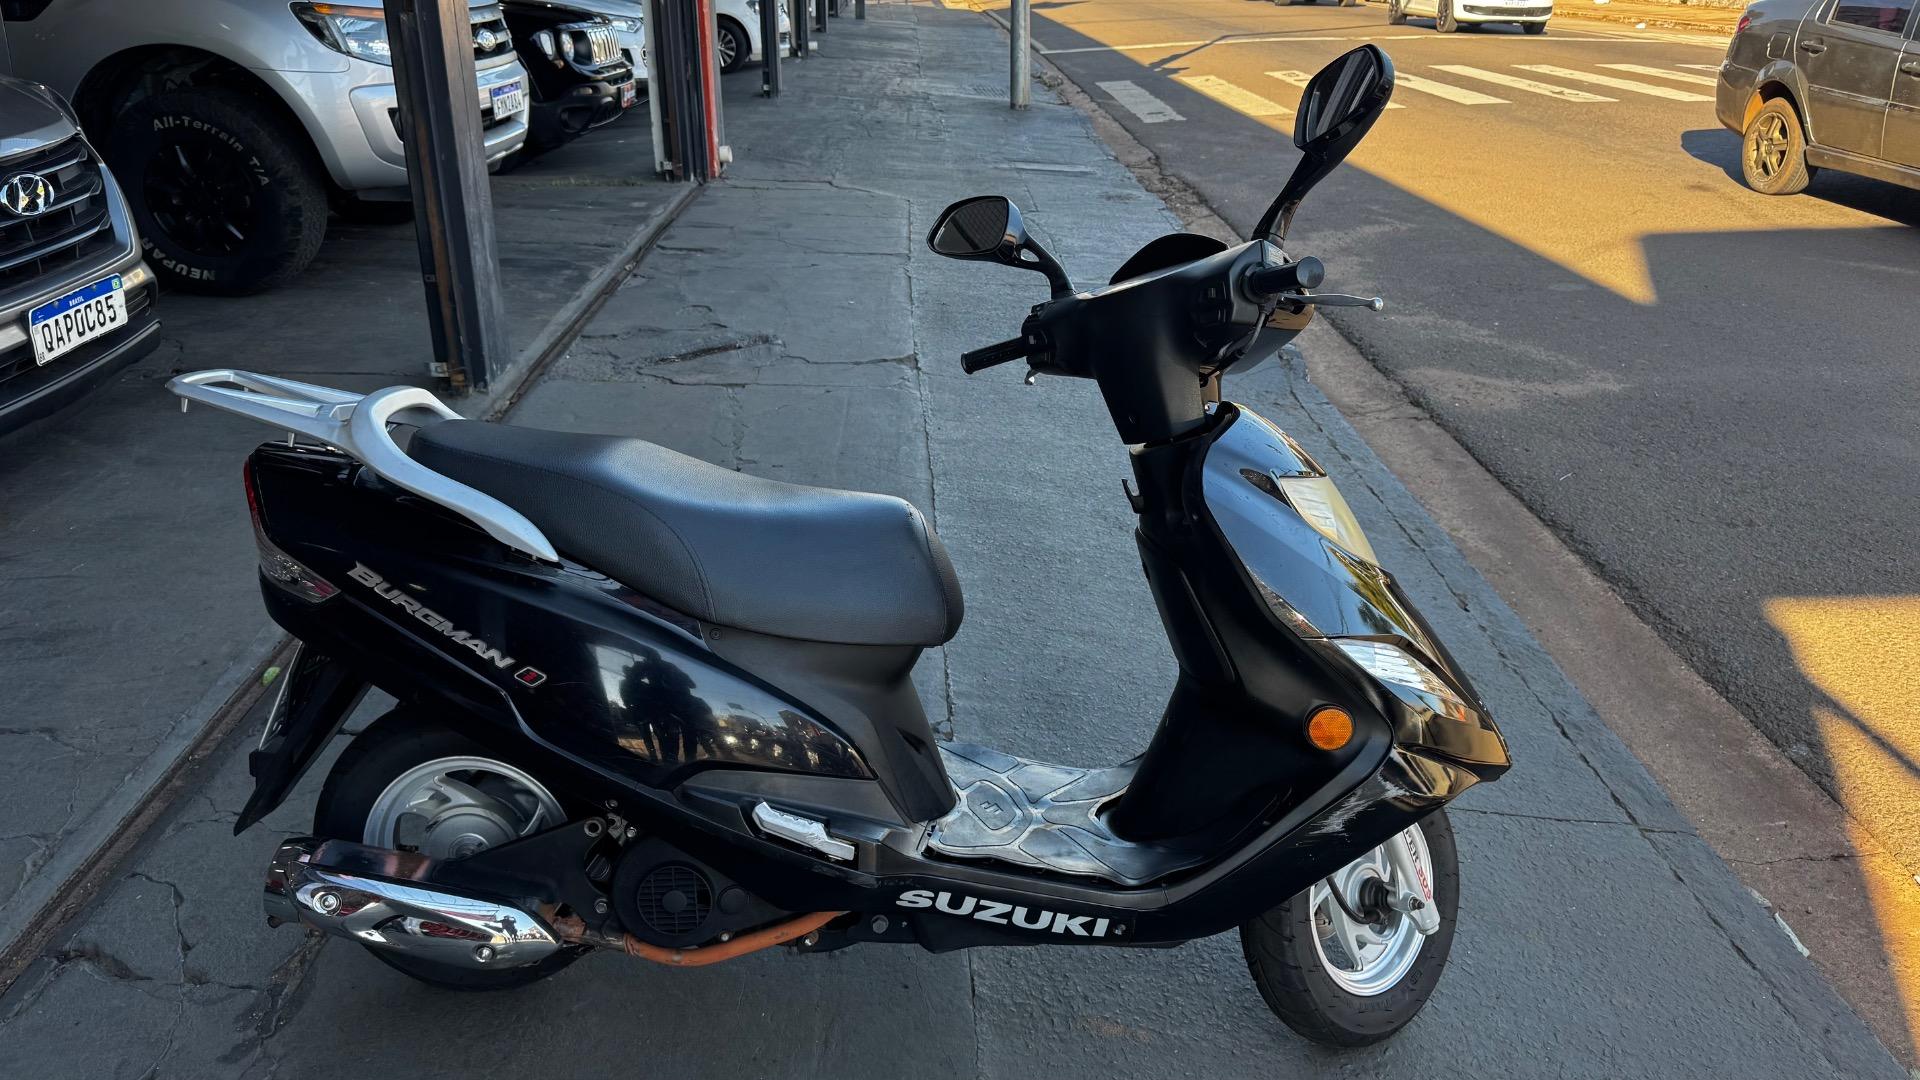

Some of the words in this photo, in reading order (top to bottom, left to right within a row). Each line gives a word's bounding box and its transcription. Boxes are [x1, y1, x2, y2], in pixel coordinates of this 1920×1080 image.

[153, 116, 244, 152] All-Terrain
[249, 156, 270, 186] T/A
[347, 560, 516, 669] BURGMAN
[895, 890, 1110, 937] SUZUKI
